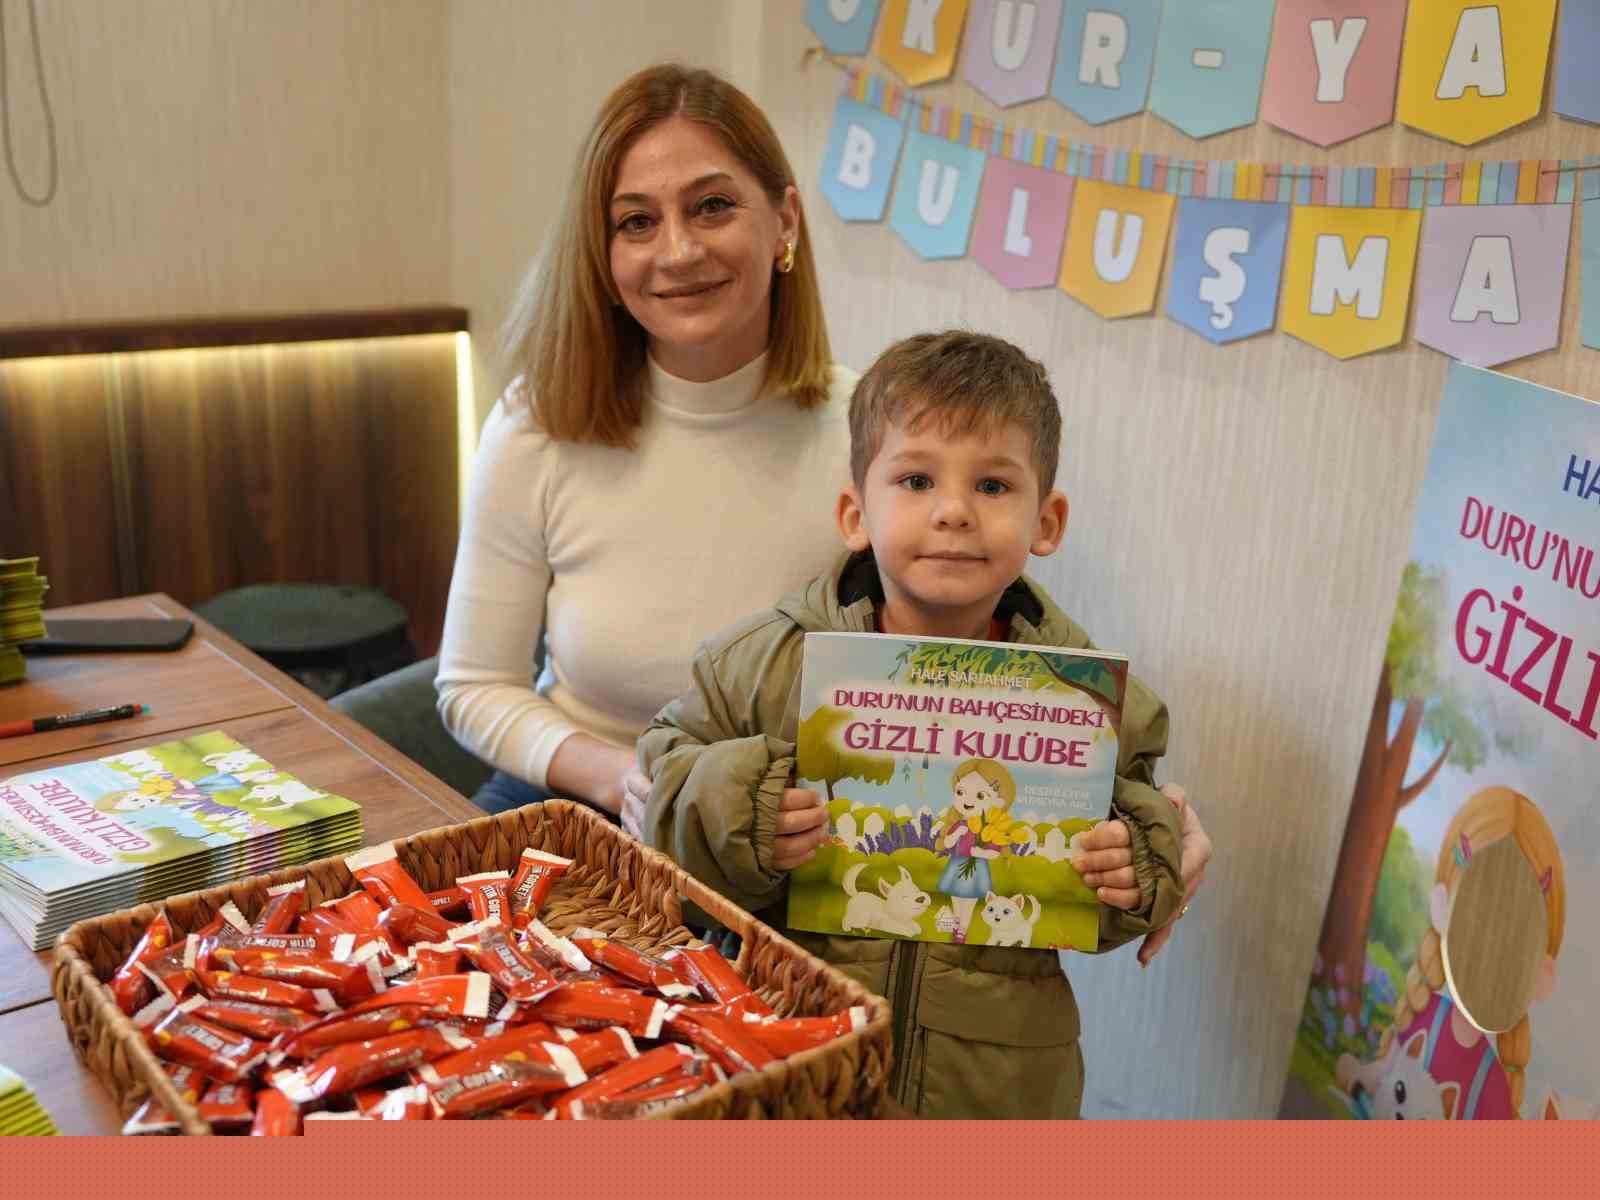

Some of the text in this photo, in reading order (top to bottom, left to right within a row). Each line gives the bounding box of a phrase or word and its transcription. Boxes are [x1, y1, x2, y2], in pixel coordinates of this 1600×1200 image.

[836, 123, 1520, 330] BULUŞMA
[834, 689, 1104, 728] DURU'NUN BAHÇESİNDEKİ
[843, 718, 1091, 768] GİZLİ KULÜBE
